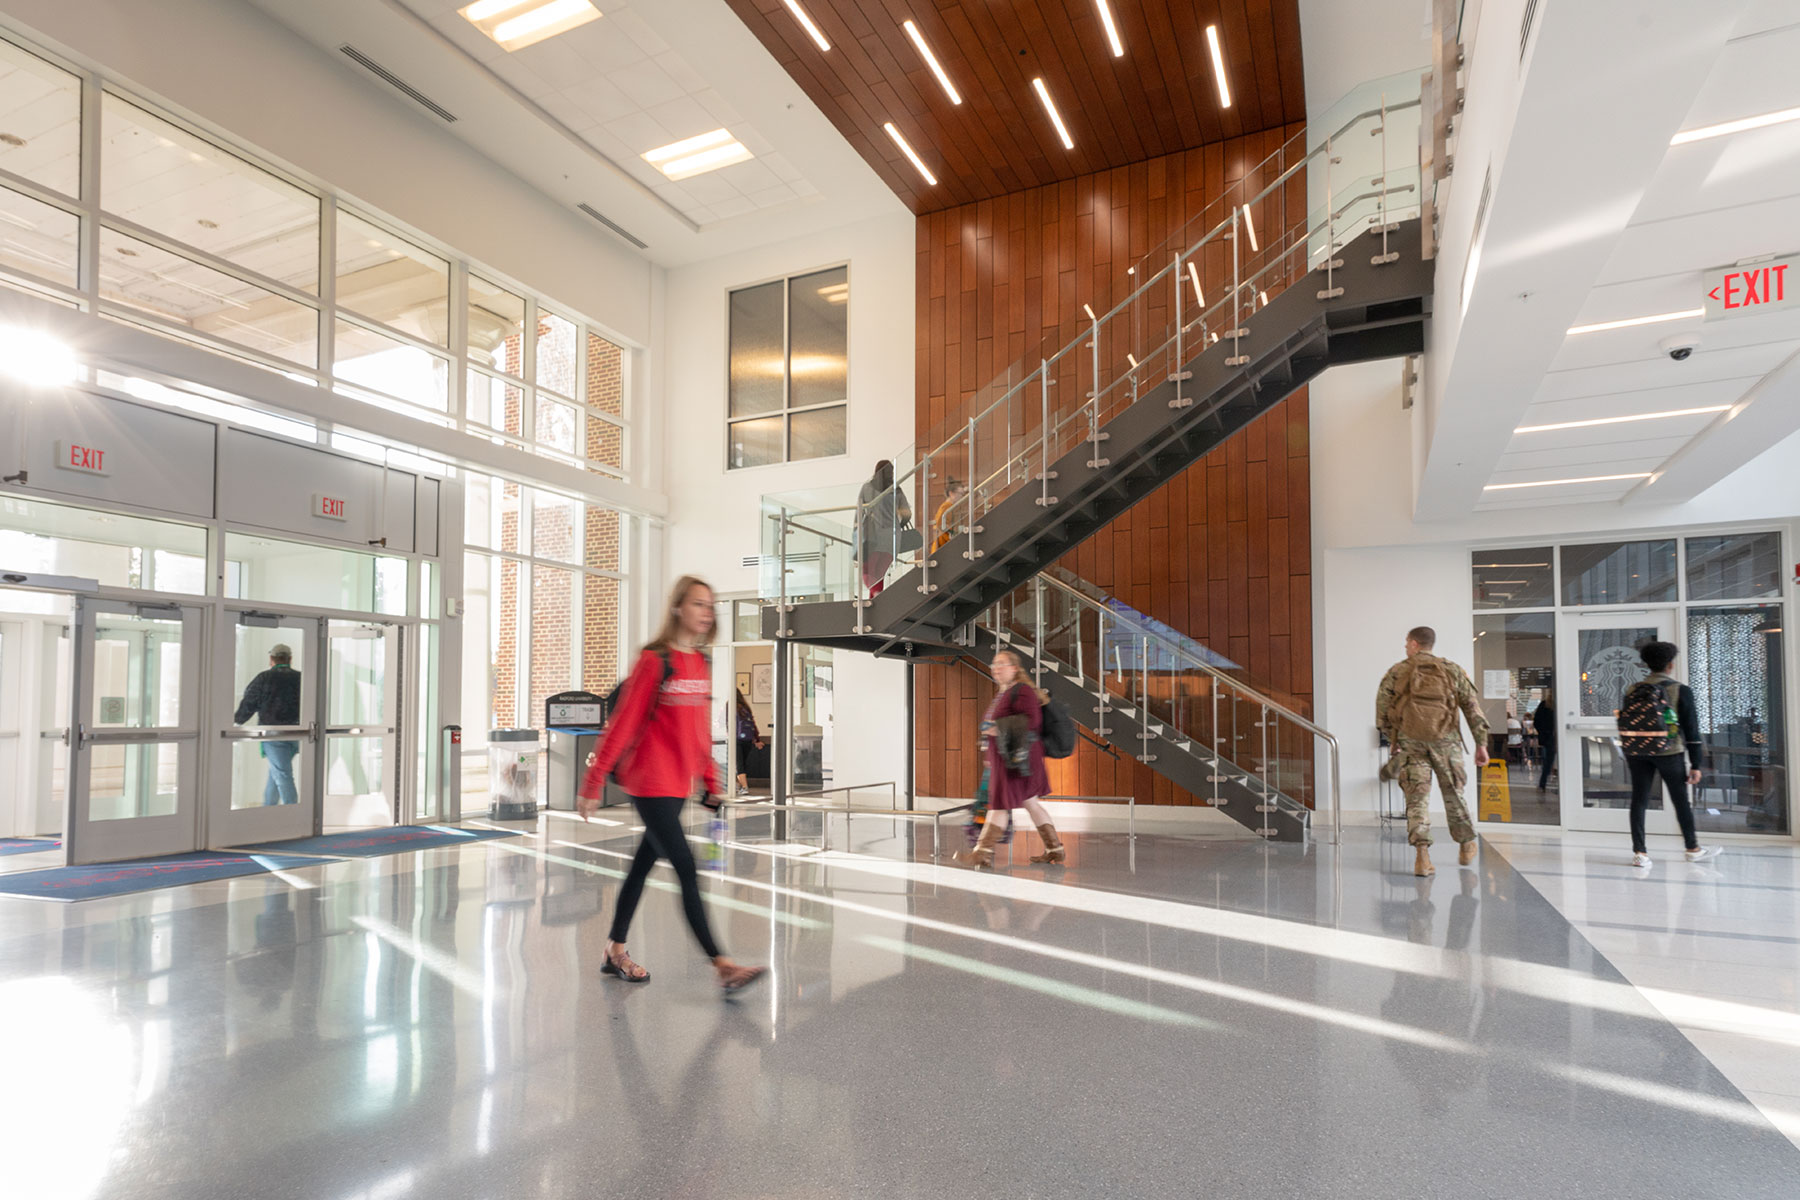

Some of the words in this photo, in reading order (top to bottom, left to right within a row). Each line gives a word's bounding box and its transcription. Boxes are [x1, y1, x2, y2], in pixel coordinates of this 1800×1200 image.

[1724, 264, 1788, 310] EXIT
[71, 444, 104, 471] EXIT
[322, 496, 345, 517] EXIT
